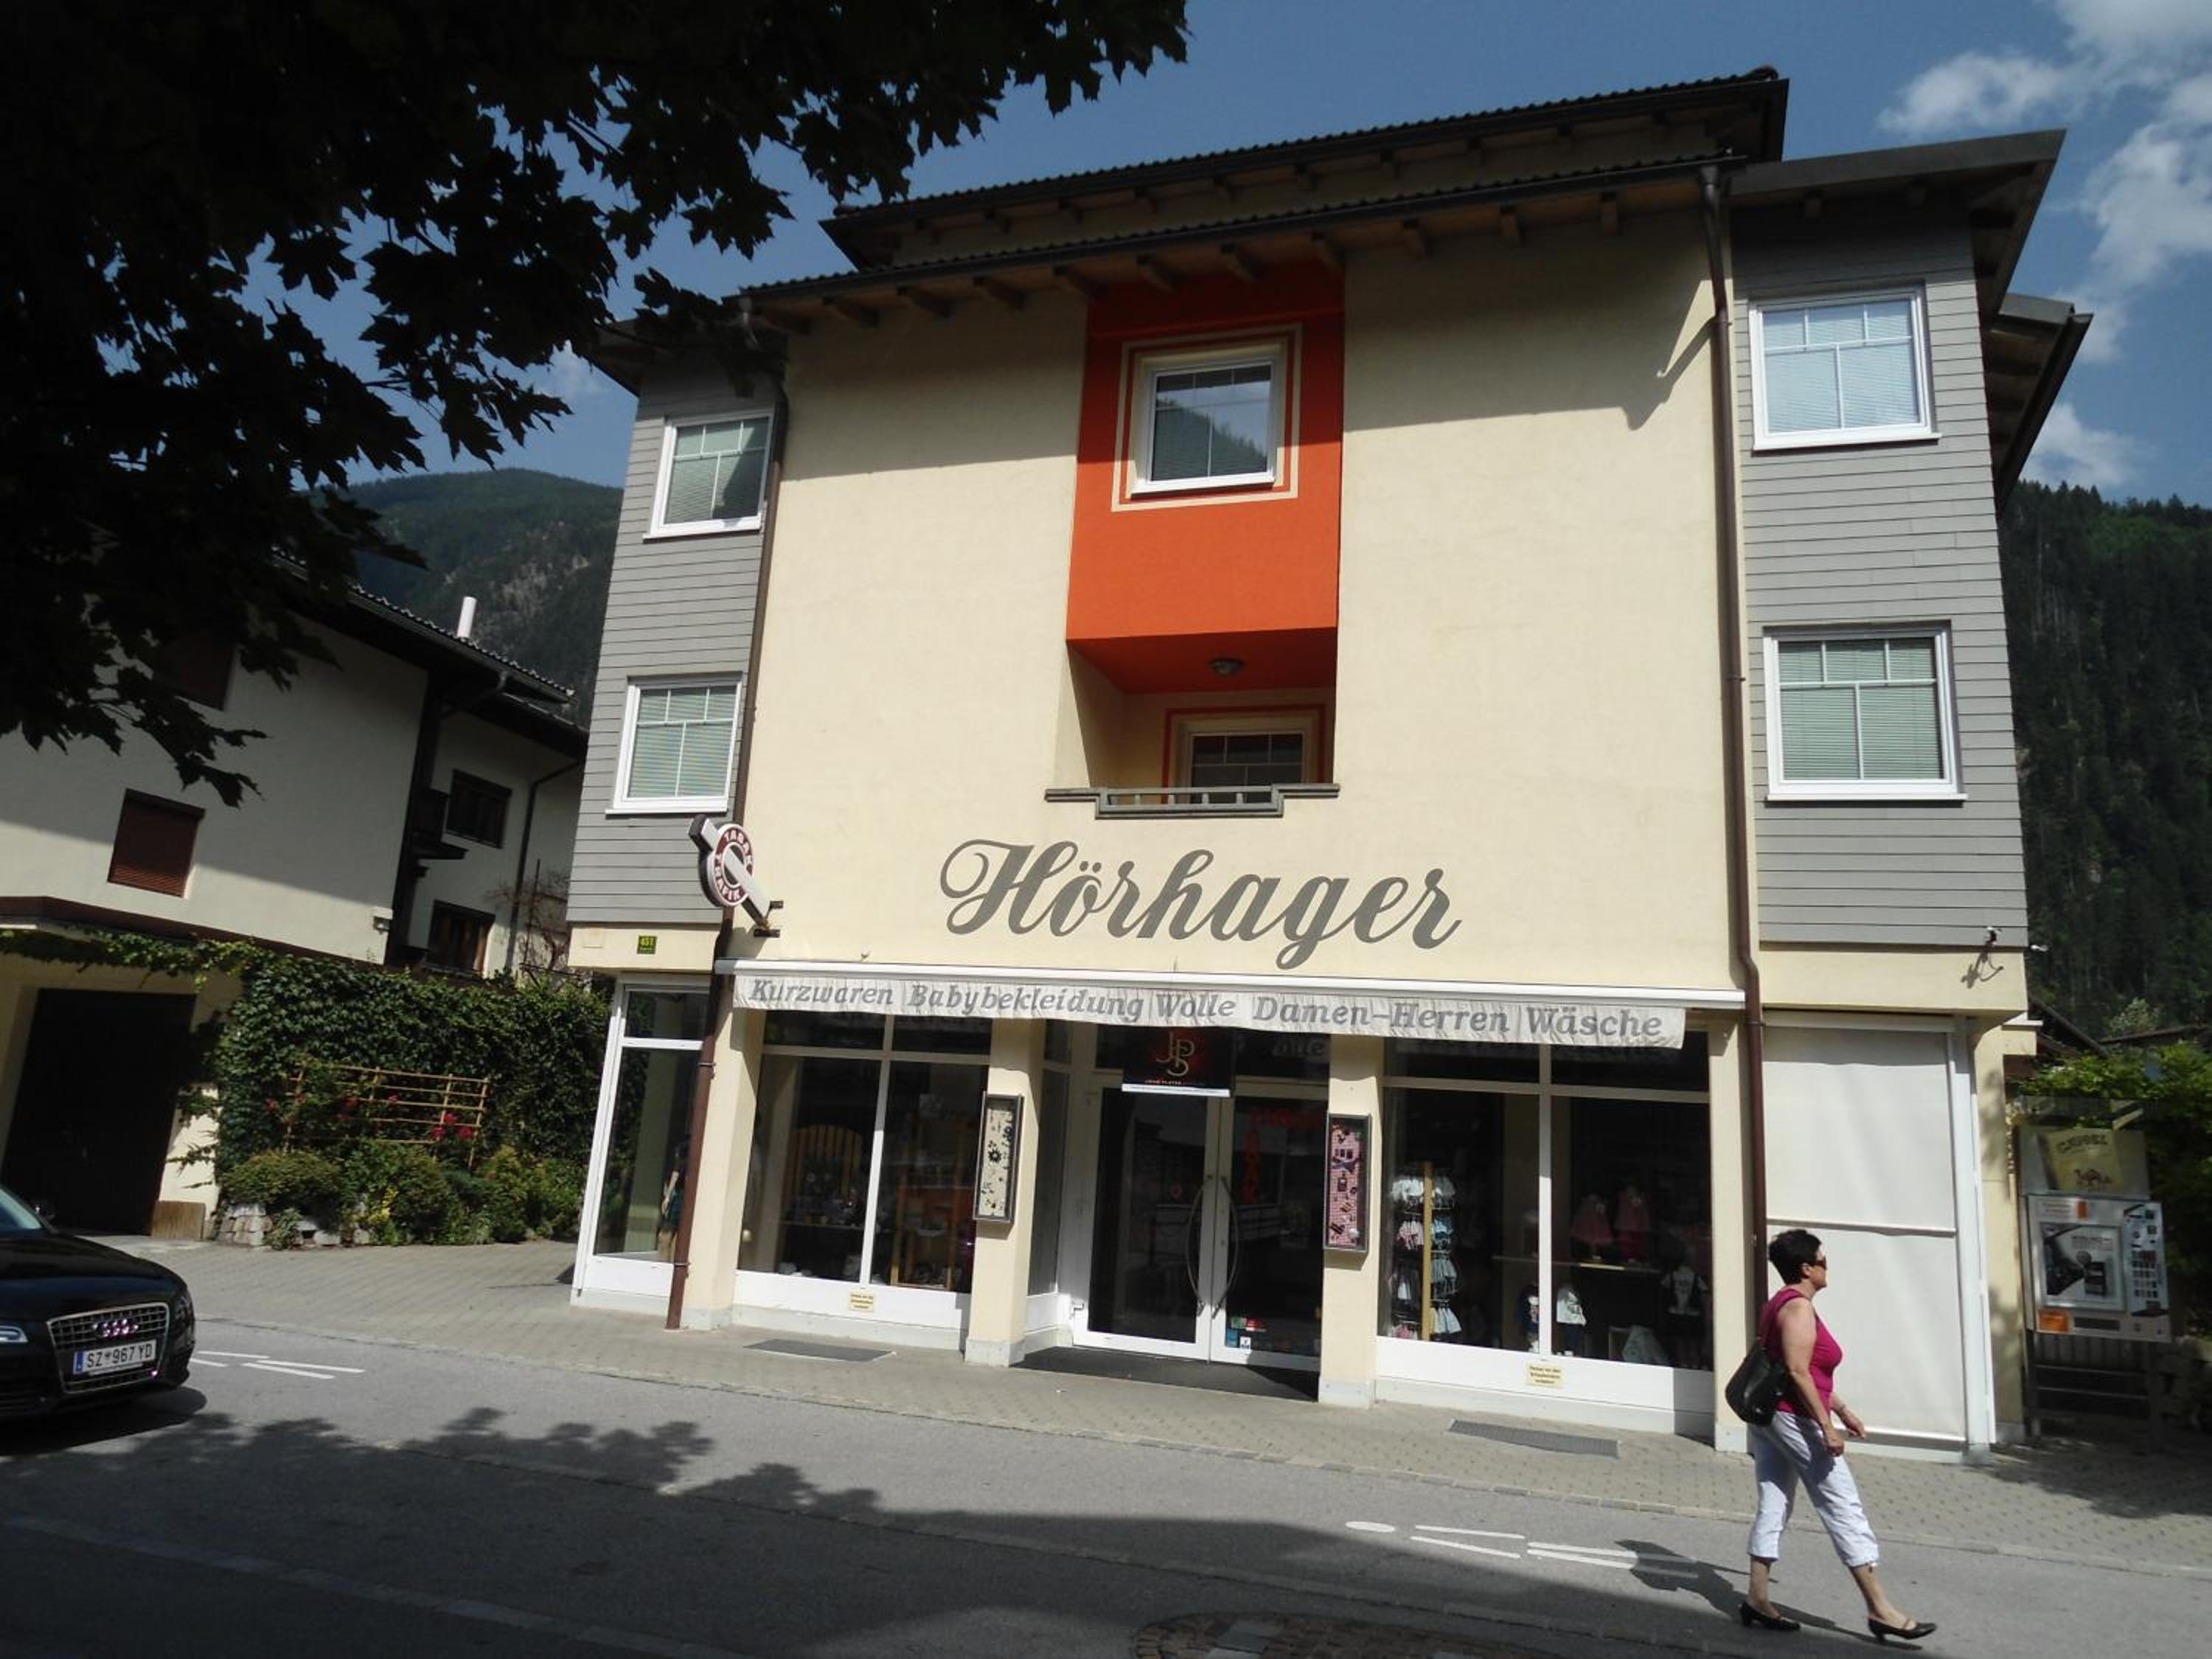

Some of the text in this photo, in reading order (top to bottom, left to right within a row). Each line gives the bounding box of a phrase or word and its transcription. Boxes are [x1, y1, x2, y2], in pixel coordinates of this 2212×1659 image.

[940, 838, 1461, 970] Hörhager
[748, 978, 893, 1005] Kurzwaren
[908, 983, 1144, 1023] Babybekleidung
[1155, 993, 1236, 1018] Wolle
[1526, 1006, 1662, 1037] Wäsche
[87, 1343, 153, 1368] SZ 967 YD
